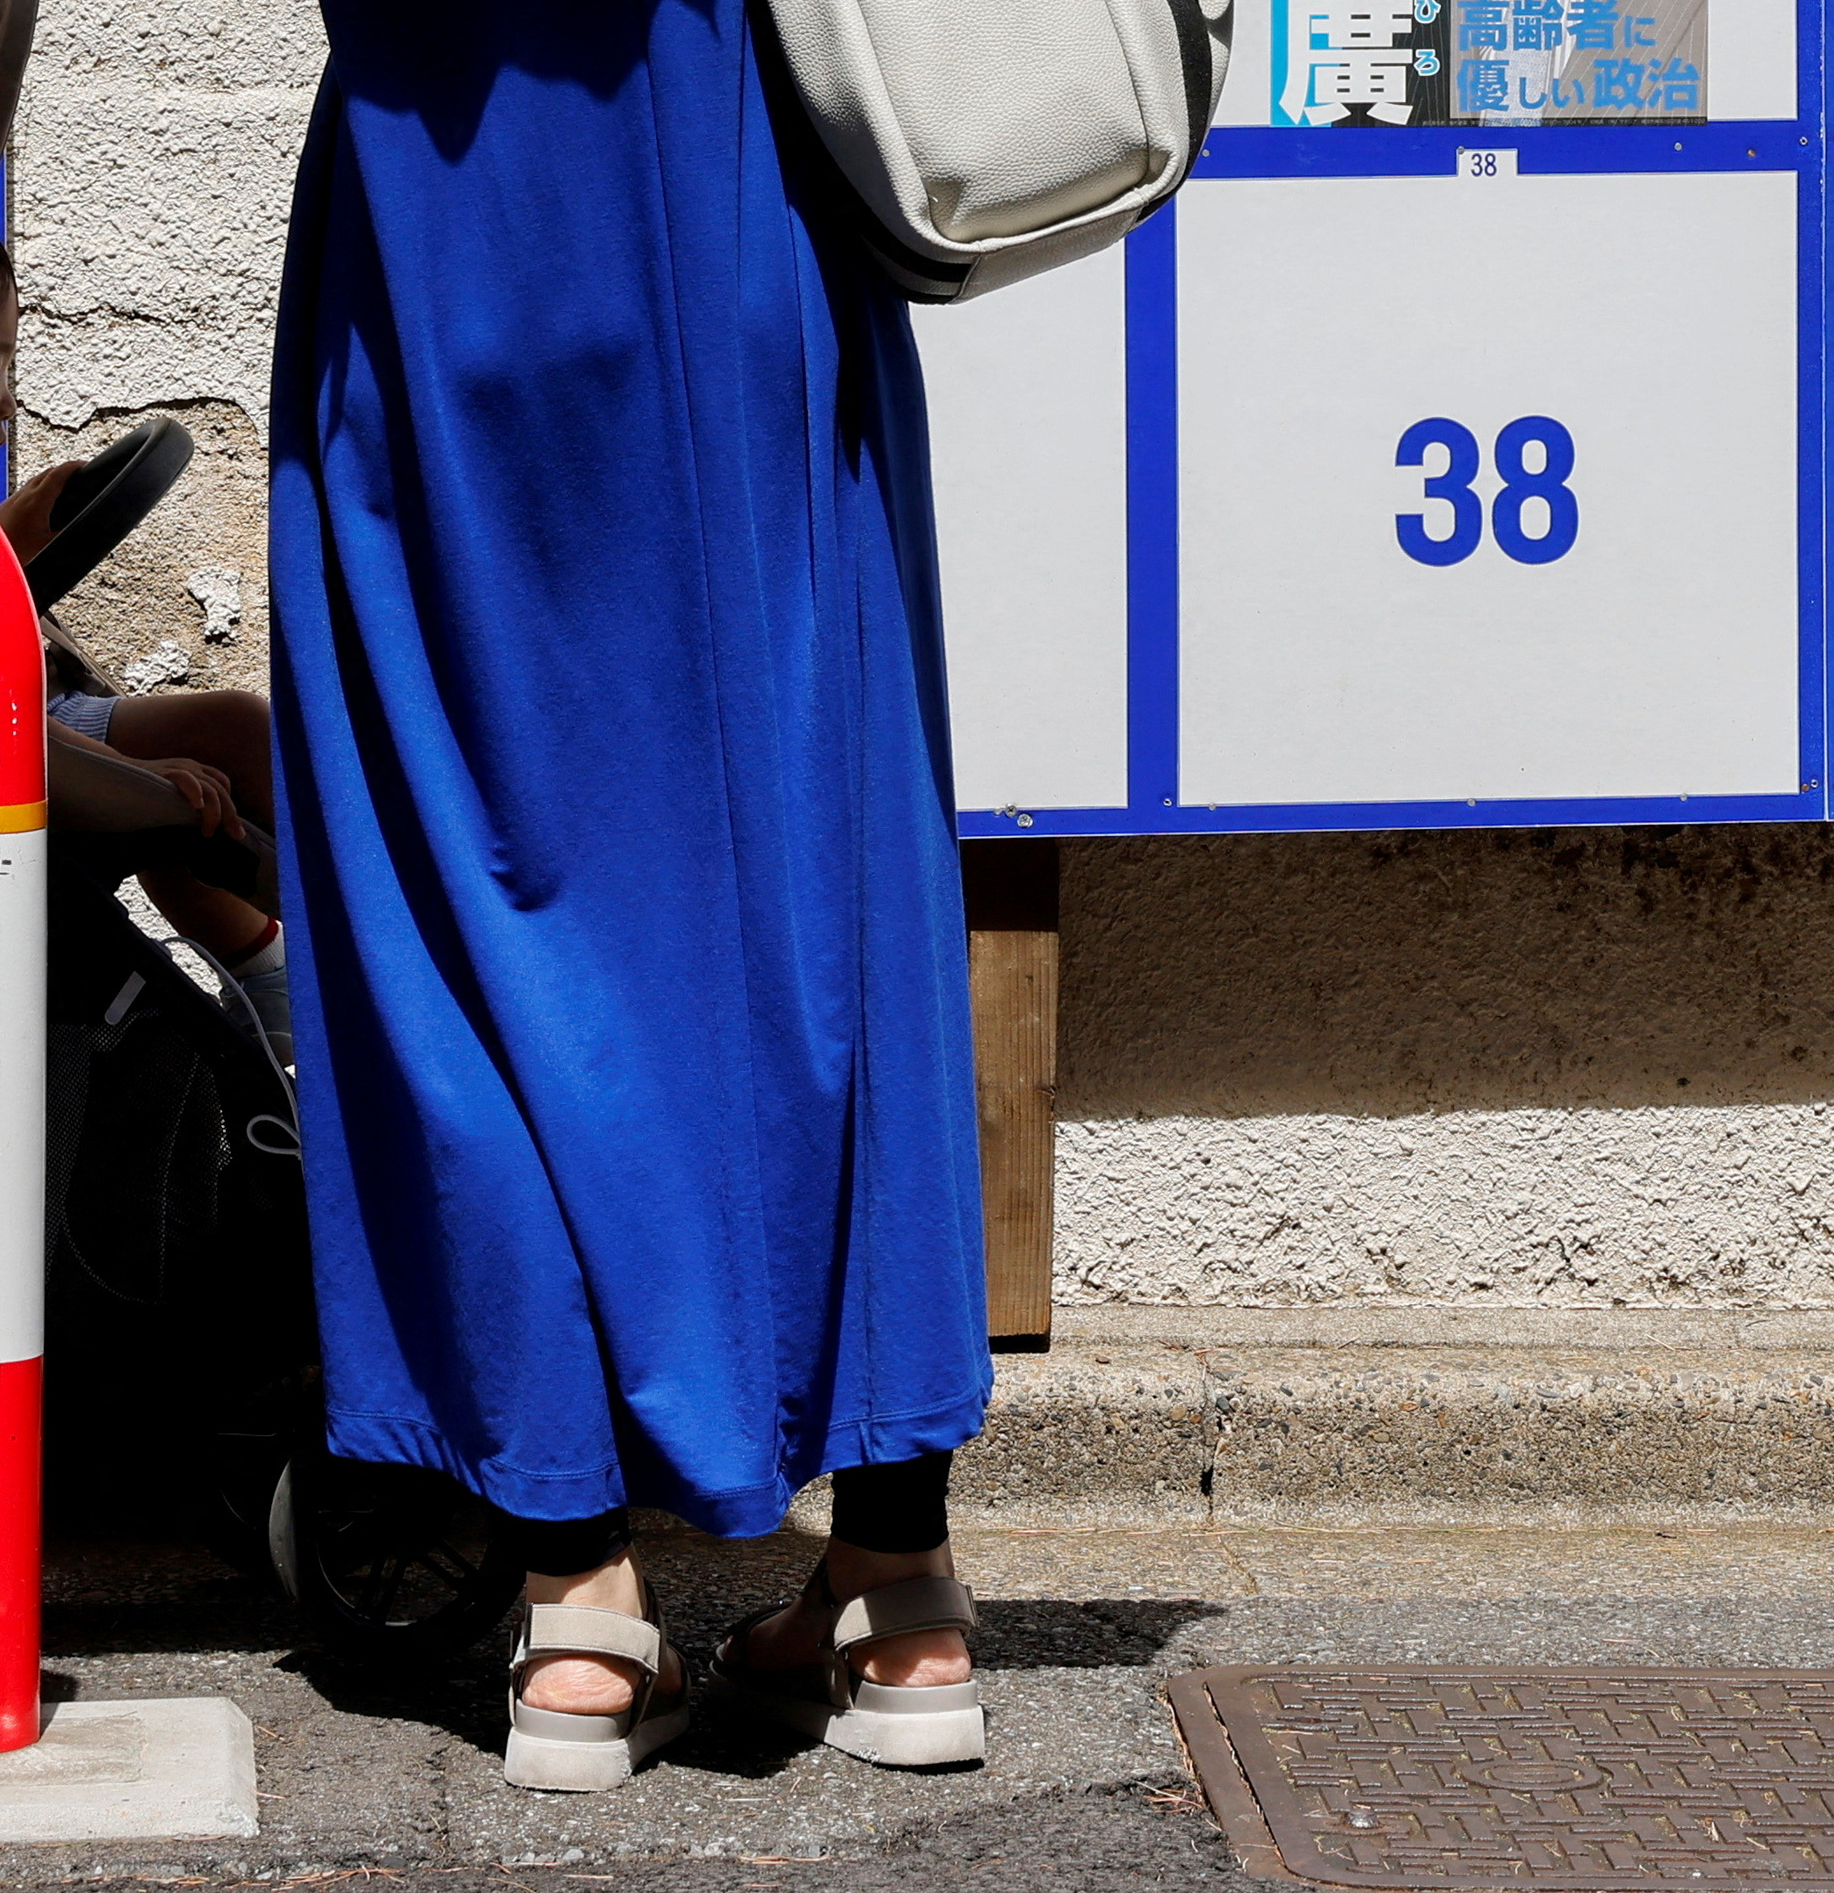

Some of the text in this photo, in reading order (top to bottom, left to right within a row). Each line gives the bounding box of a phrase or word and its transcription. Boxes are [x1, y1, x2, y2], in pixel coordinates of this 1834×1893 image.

[1457, 0, 1656, 53] 高齢者に
[1457, 58, 1700, 113] 優しい政治
[1470, 154, 1498, 178] 38
[1393, 415, 1580, 567] 38
